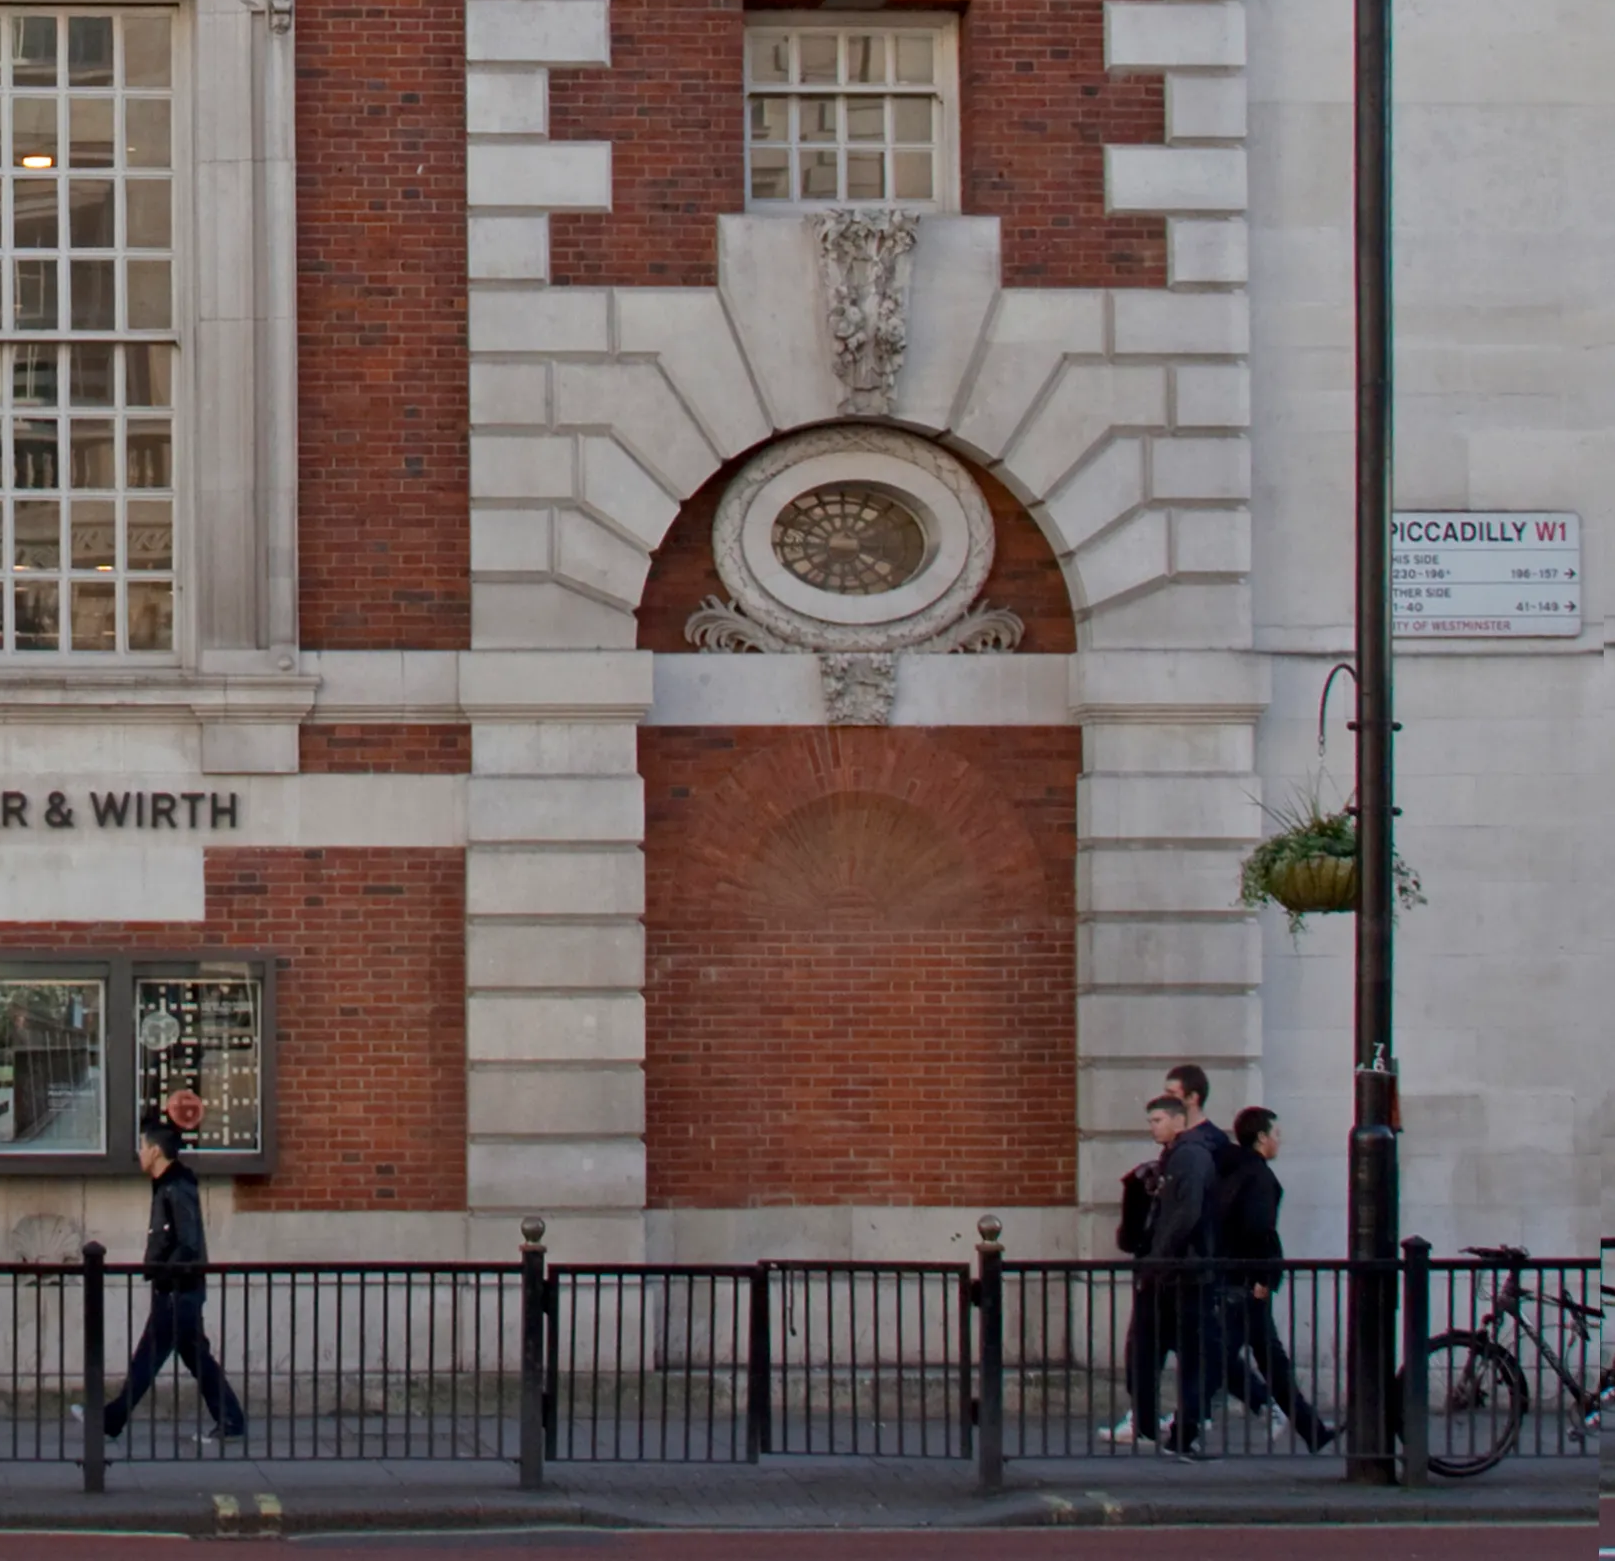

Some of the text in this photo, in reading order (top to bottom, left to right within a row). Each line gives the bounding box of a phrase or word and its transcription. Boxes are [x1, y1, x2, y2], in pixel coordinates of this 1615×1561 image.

[1535, 521, 1566, 542] W1
[1393, 554, 1440, 565] HIS SIDE
[1393, 588, 1452, 598] THER SIDE
[1392, 621, 1511, 631] ITY OF WESTMINSTER
[44, 791, 74, 828] &
[90, 791, 237, 829] WIRTH
